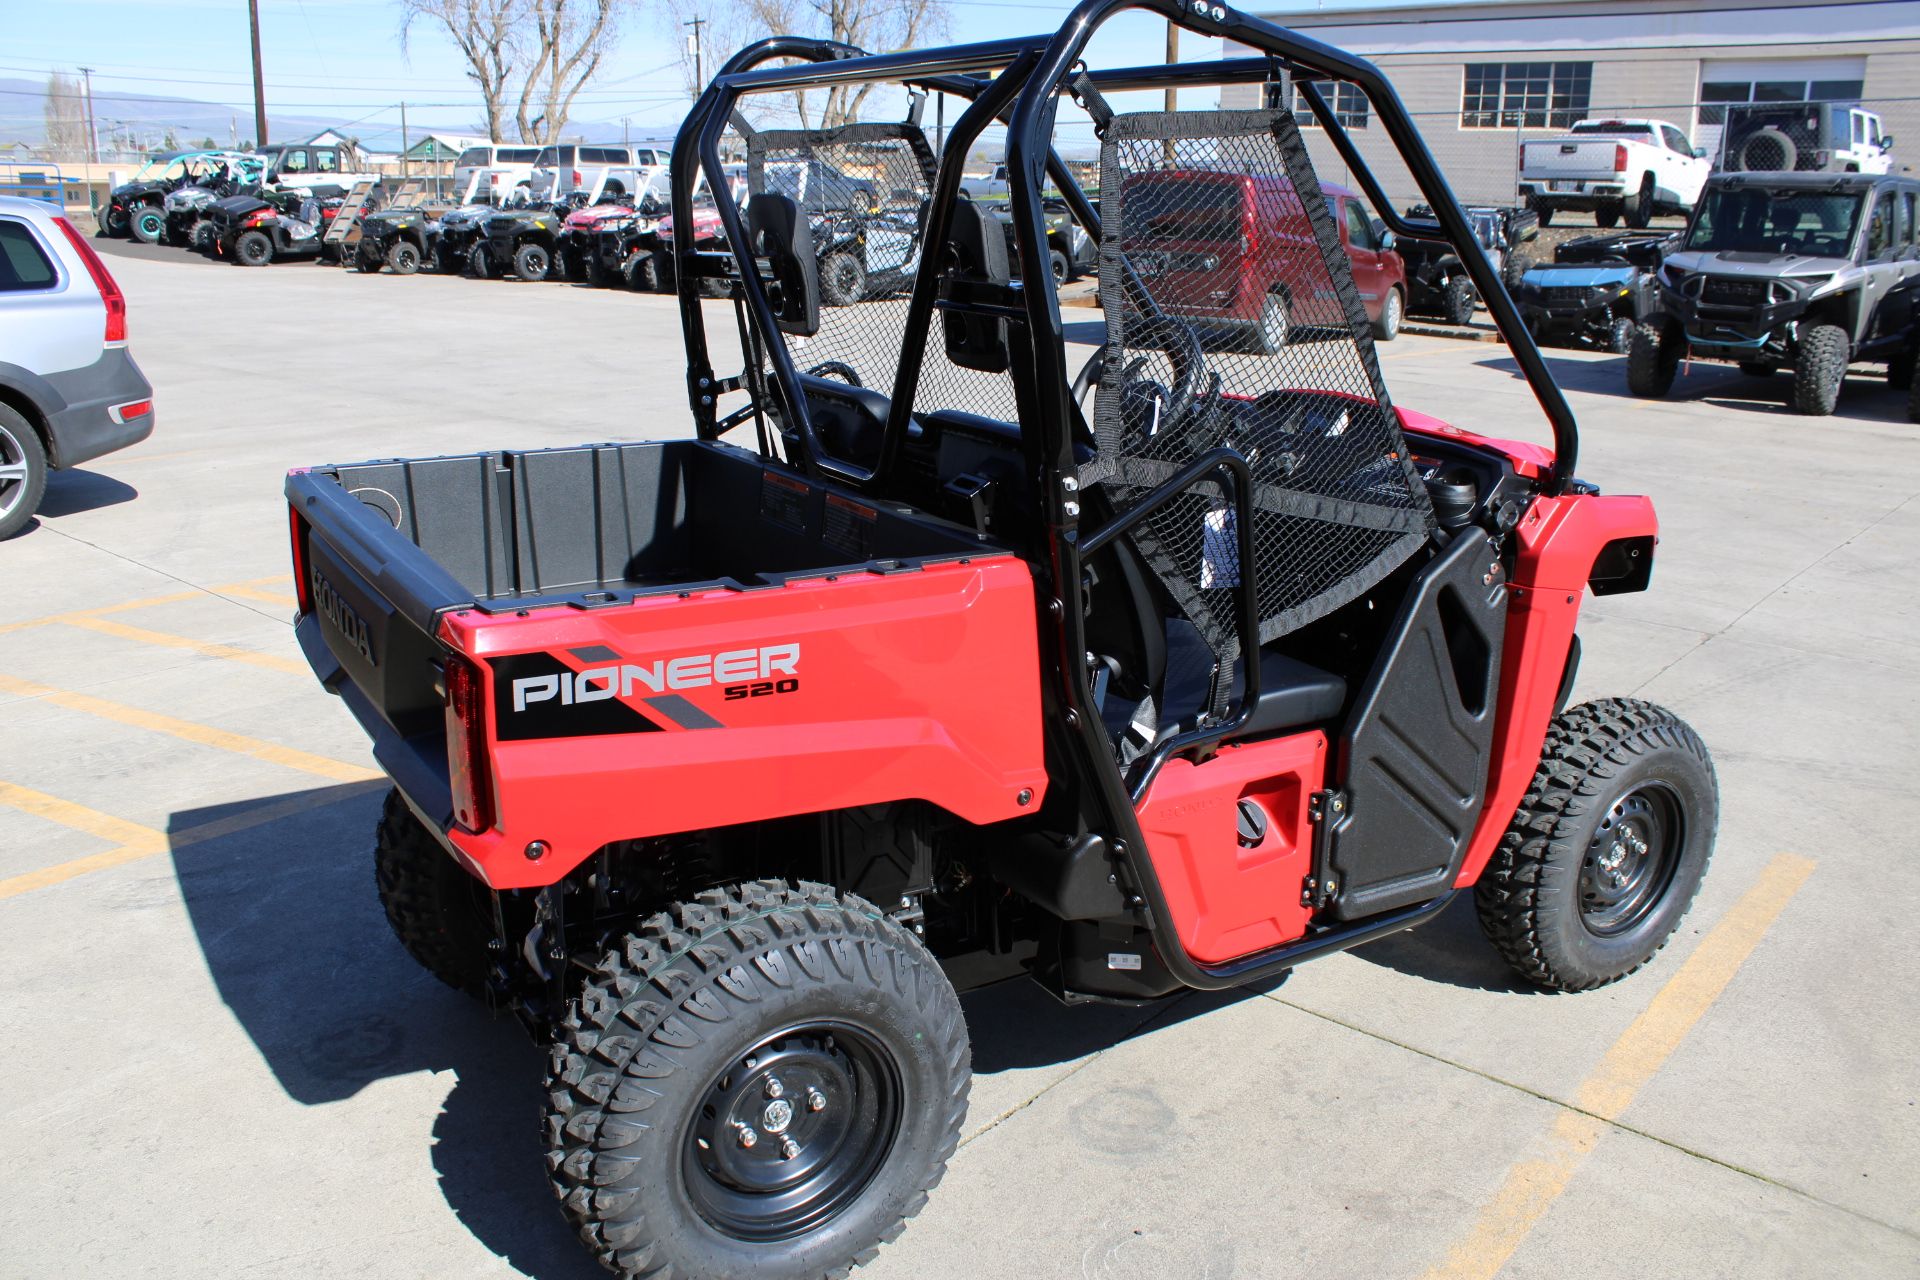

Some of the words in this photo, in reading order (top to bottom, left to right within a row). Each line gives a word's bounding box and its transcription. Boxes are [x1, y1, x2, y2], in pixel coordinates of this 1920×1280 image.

[312, 565, 375, 667] HONDA
[512, 643, 800, 713] PIONEER
[724, 678, 799, 701] 520
